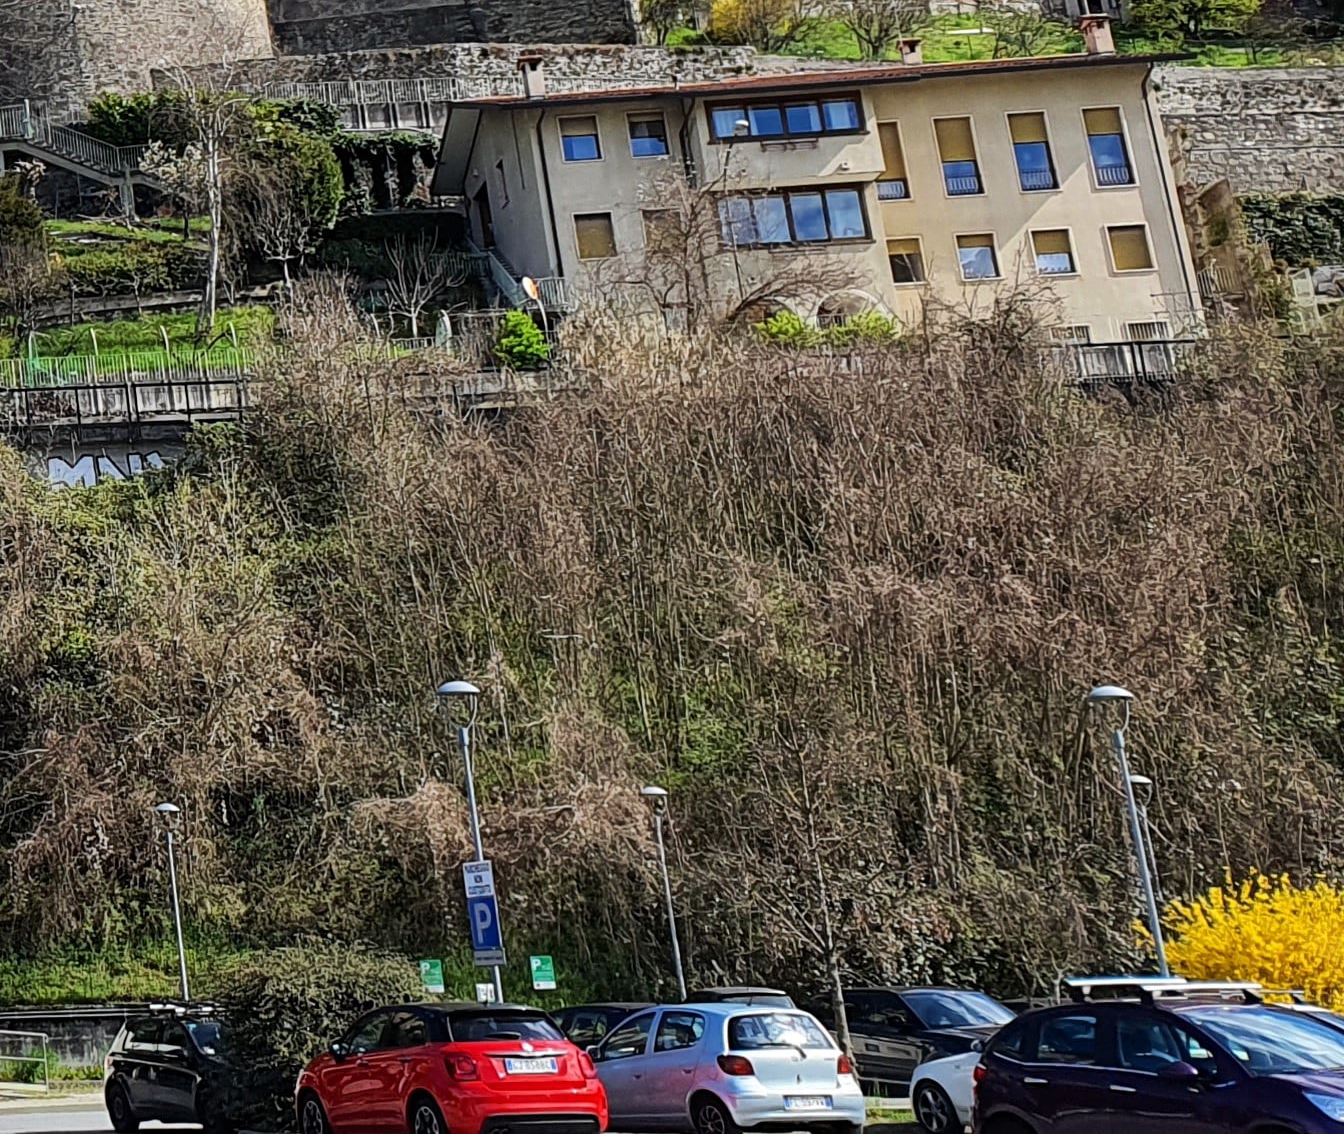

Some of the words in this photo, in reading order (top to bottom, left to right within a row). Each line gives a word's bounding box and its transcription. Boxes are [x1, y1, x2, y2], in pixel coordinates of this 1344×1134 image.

[474, 902, 492, 944] P
[420, 962, 430, 975] P
[531, 959, 542, 971] P
